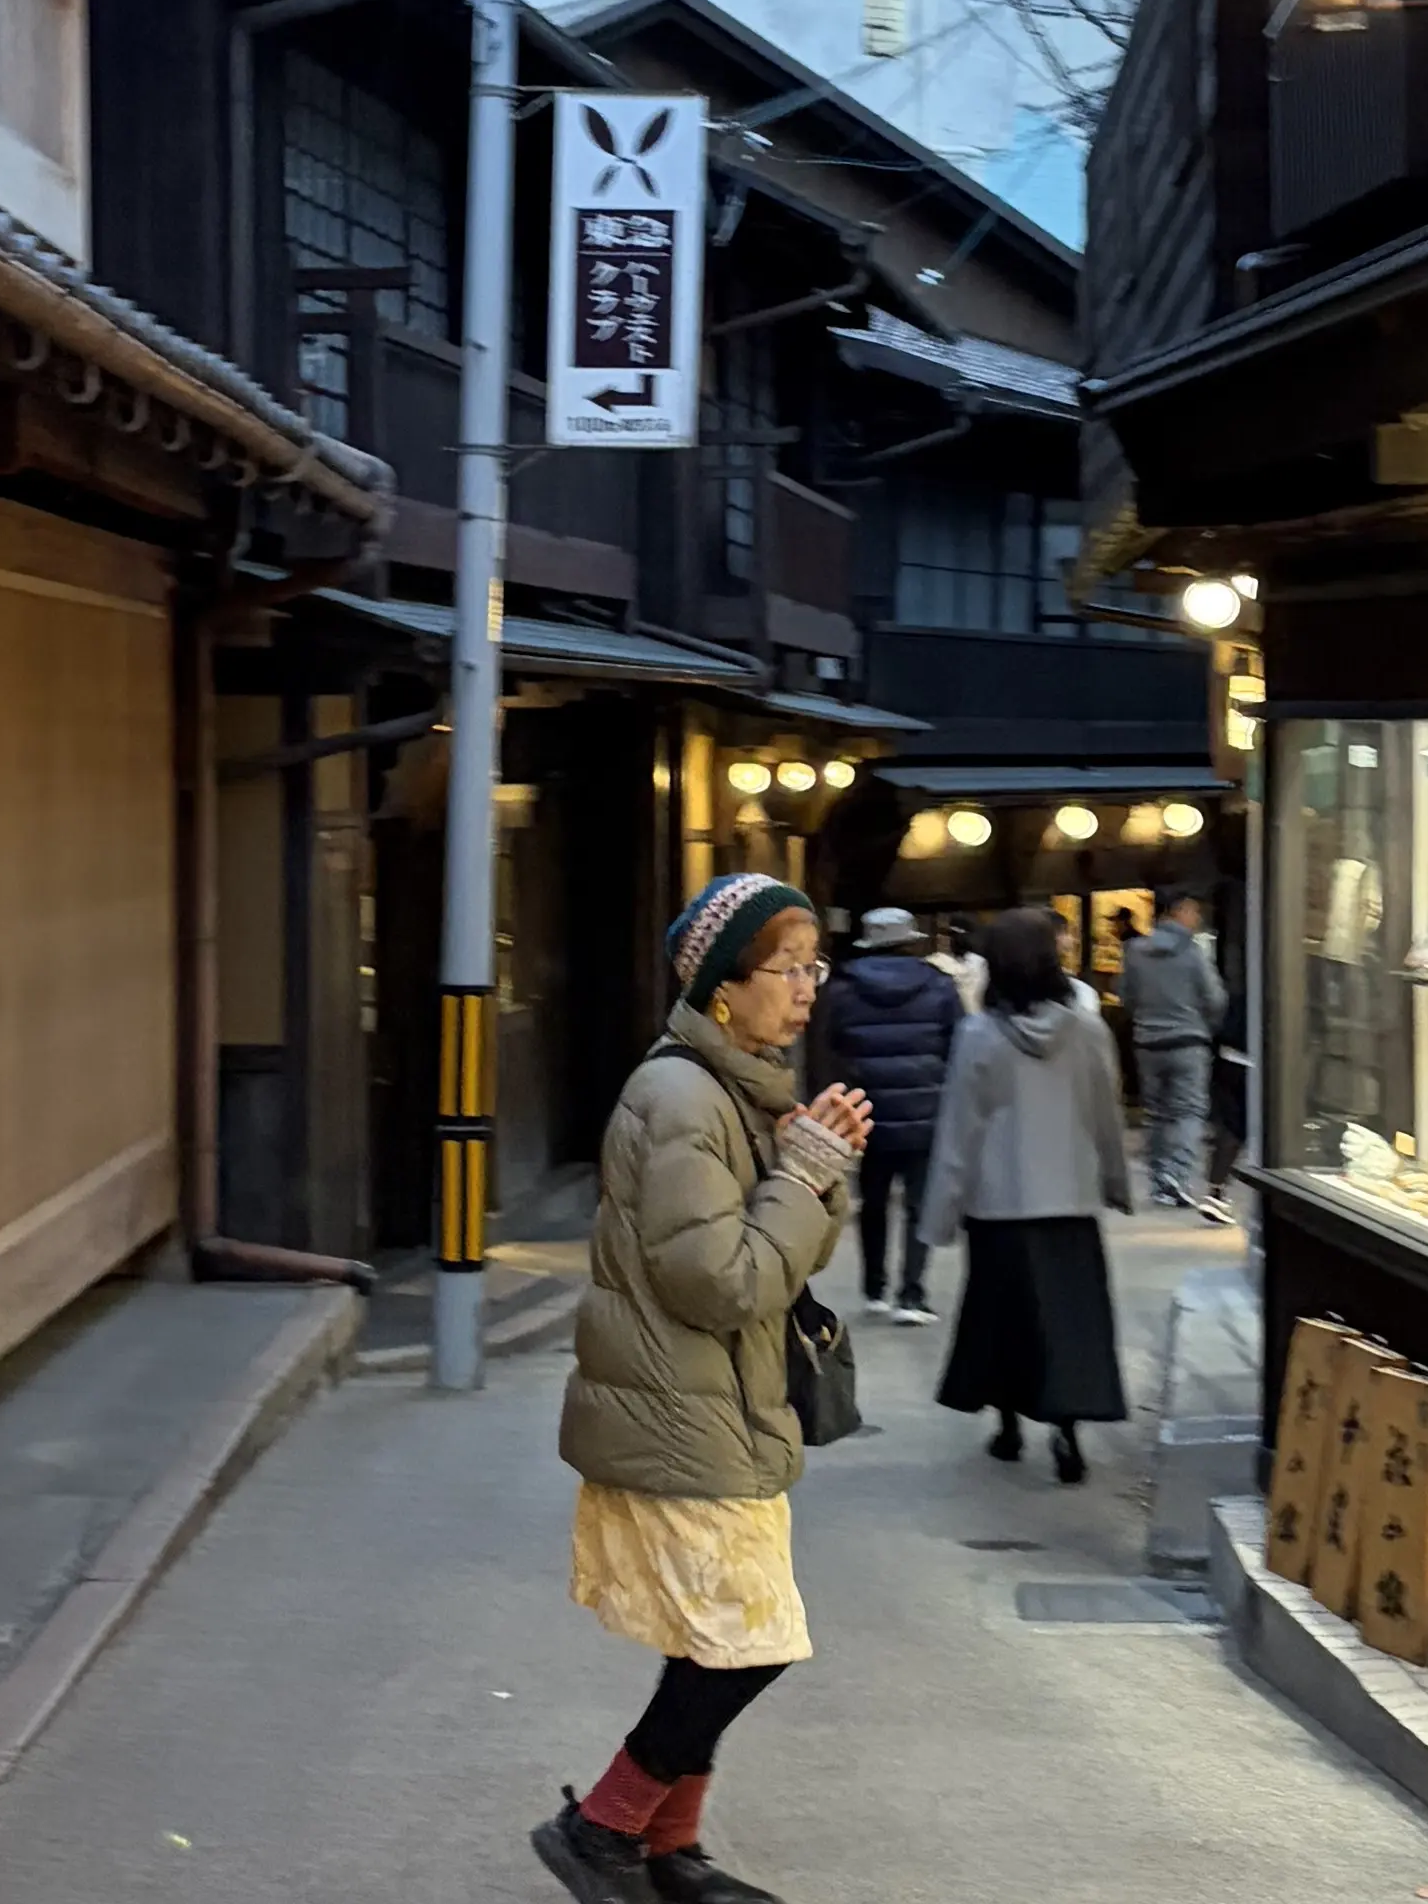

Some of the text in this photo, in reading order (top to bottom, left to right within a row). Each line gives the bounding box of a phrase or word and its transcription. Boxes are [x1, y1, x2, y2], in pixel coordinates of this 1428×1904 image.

[581, 213, 672, 249] 東急
[586, 260, 625, 342] クラブ
